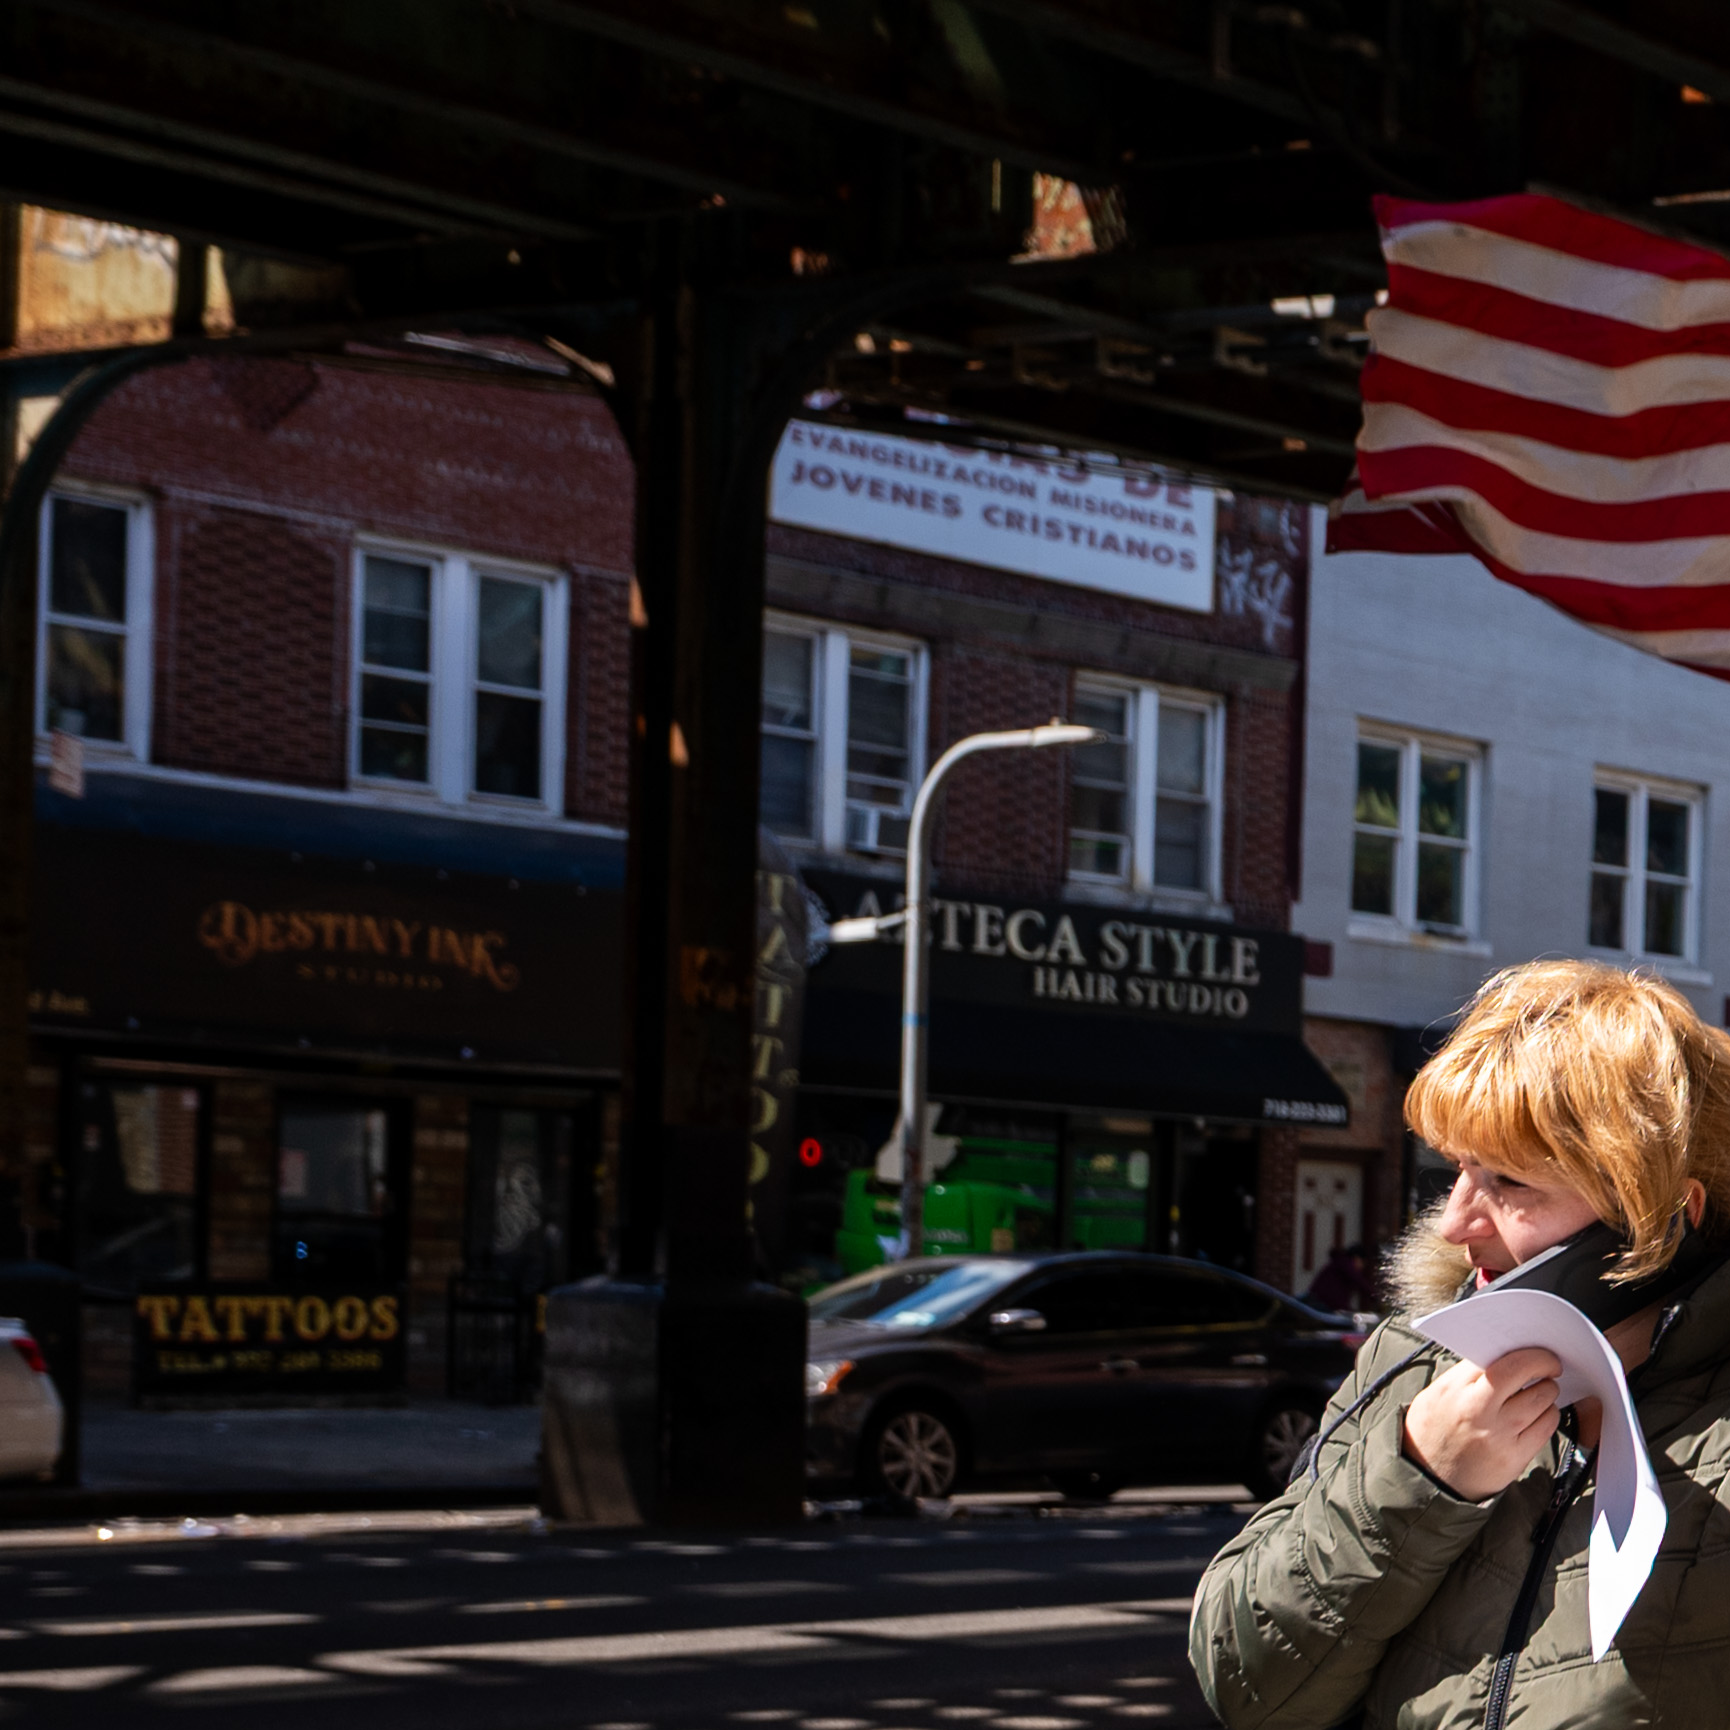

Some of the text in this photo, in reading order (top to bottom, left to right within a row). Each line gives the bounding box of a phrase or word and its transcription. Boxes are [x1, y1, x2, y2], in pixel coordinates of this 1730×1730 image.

[788, 427, 1038, 500] EVANGELIZACION
[1049, 488, 1198, 539] MISIONERA
[789, 460, 965, 521] JOVENES
[981, 503, 1199, 573] CRISTIANOS
[196, 899, 522, 992] DESTINY INK
[1098, 918, 1262, 986] STYLE
[1032, 964, 1250, 1020] HAIR STUDIO
[134, 1293, 401, 1344] TATTOOS
